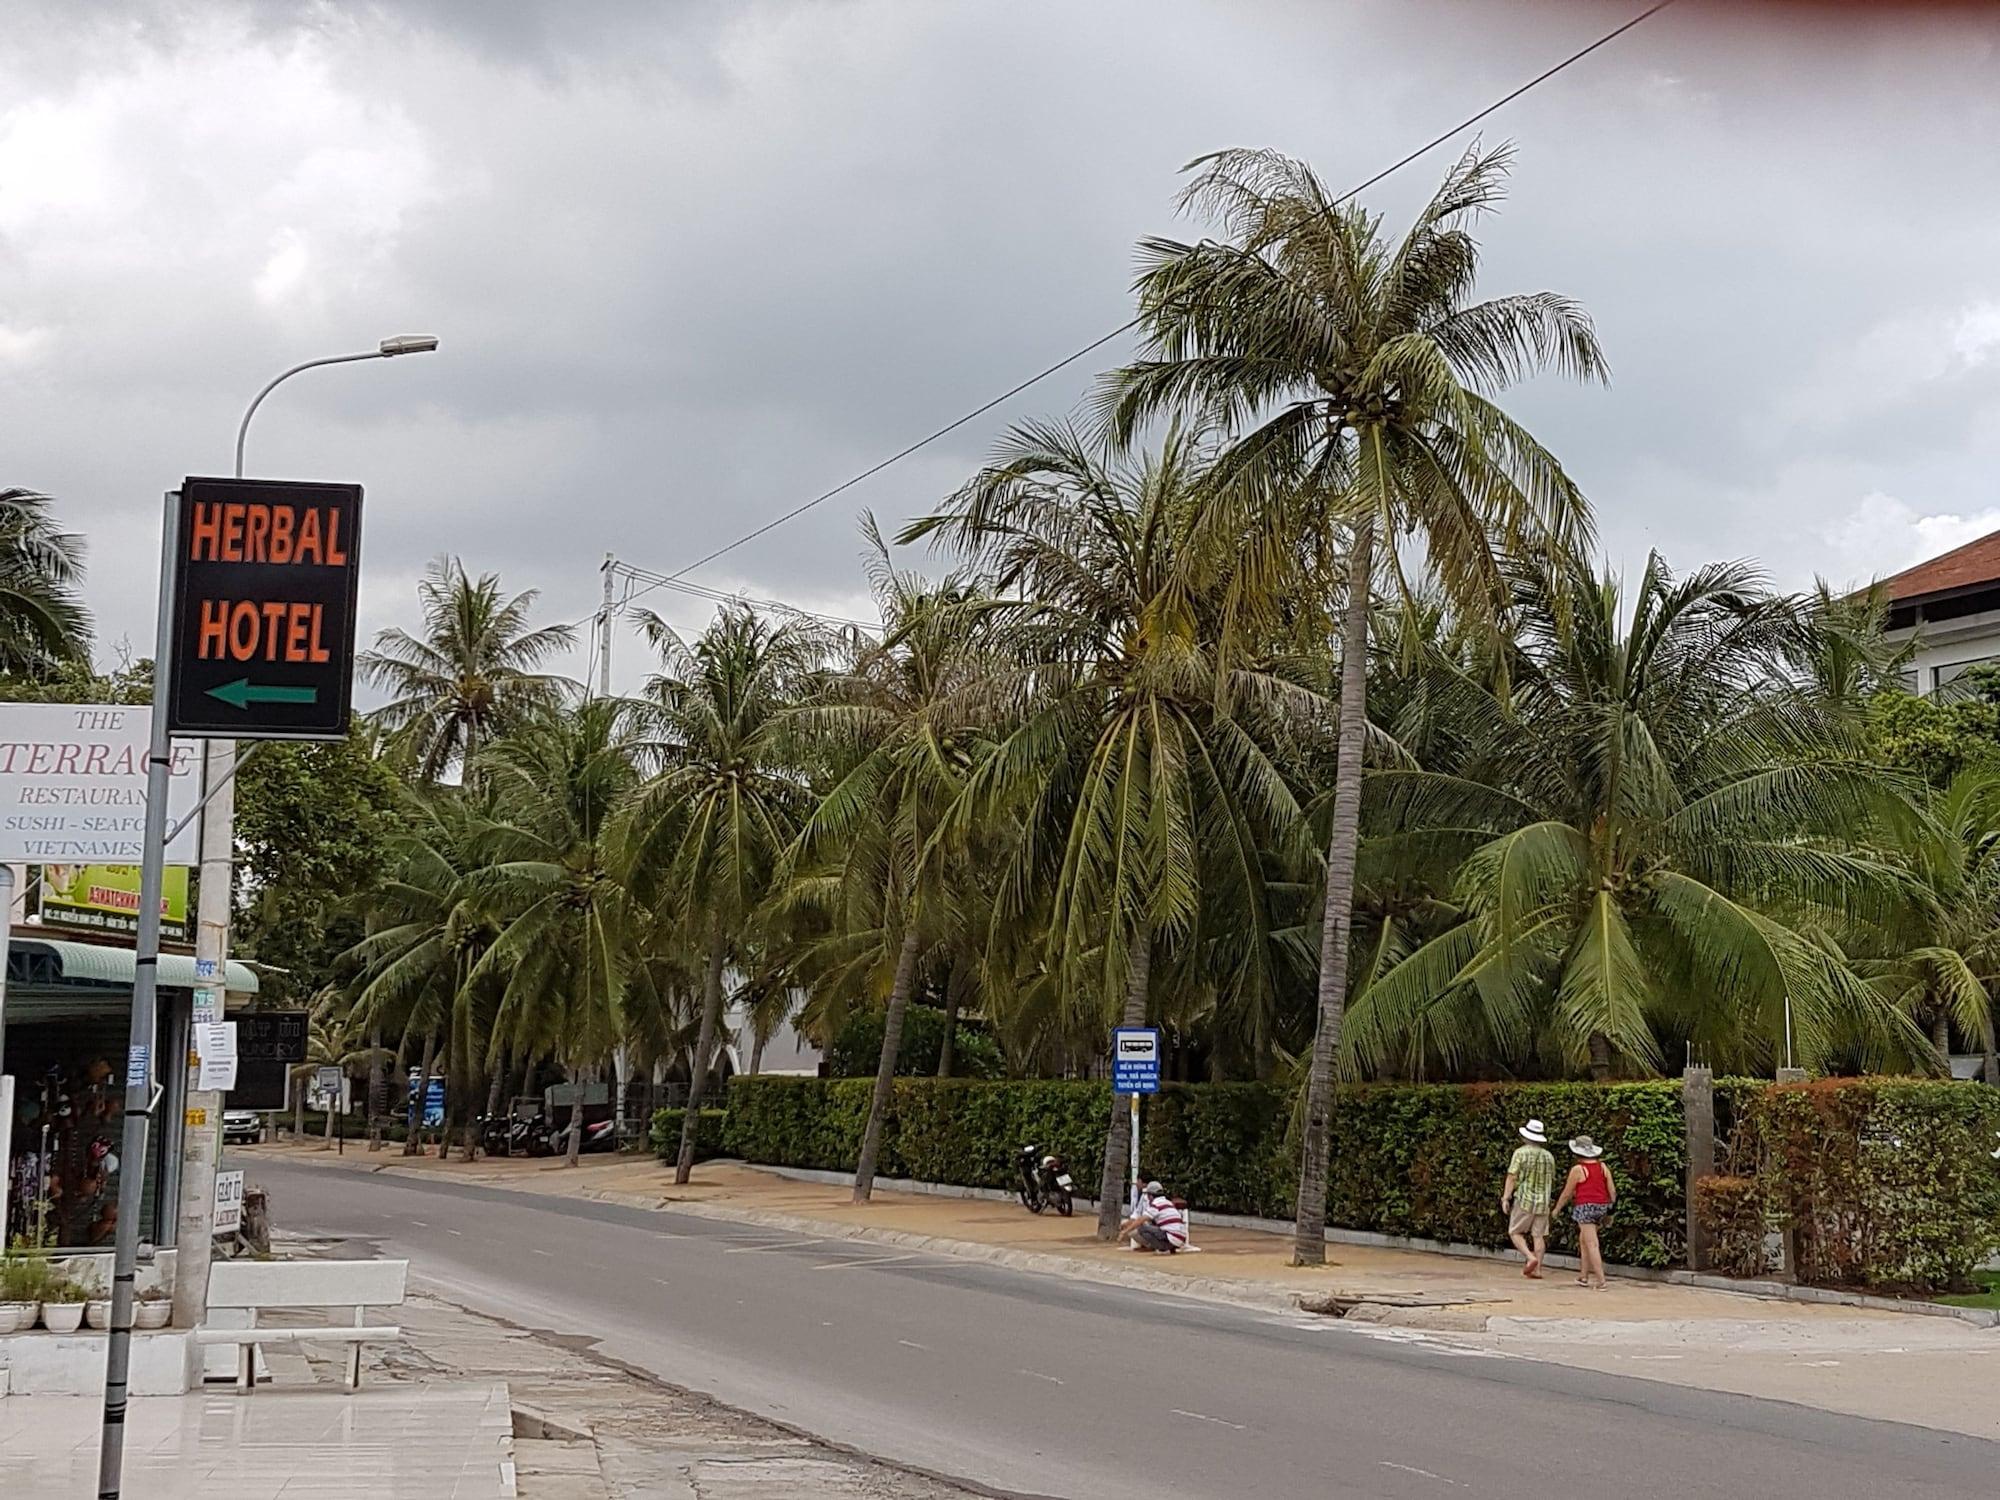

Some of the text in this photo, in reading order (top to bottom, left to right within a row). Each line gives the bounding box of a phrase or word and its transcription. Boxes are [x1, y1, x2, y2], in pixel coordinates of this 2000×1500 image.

[191, 502, 347, 567] HERBAL
[198, 600, 331, 663] HOTEL
[75, 711, 125, 731] THE
[18, 787, 149, 805] RESTAURAN
[5, 816, 65, 831] SUSHI
[82, 816, 178, 833] SEAFOD
[24, 840, 142, 856] VIETNAMES
